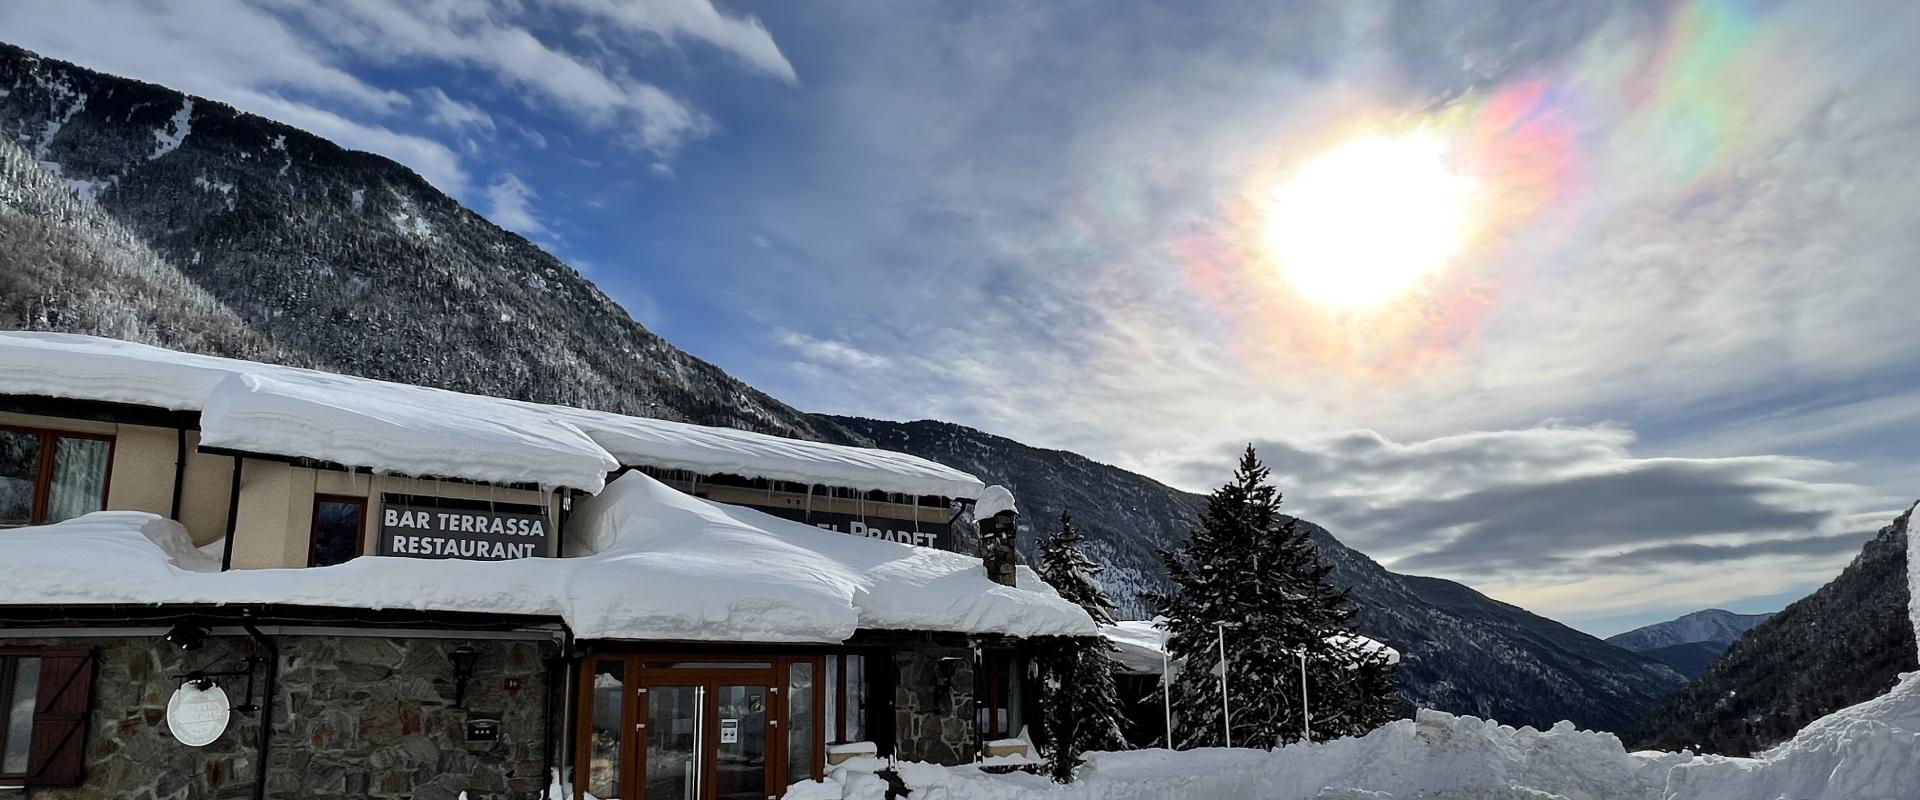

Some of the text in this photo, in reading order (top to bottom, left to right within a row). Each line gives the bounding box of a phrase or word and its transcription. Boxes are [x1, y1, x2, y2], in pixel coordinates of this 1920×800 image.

[385, 509, 544, 537] BAR TERRASSA
[392, 535, 536, 559] RESTAURANT
